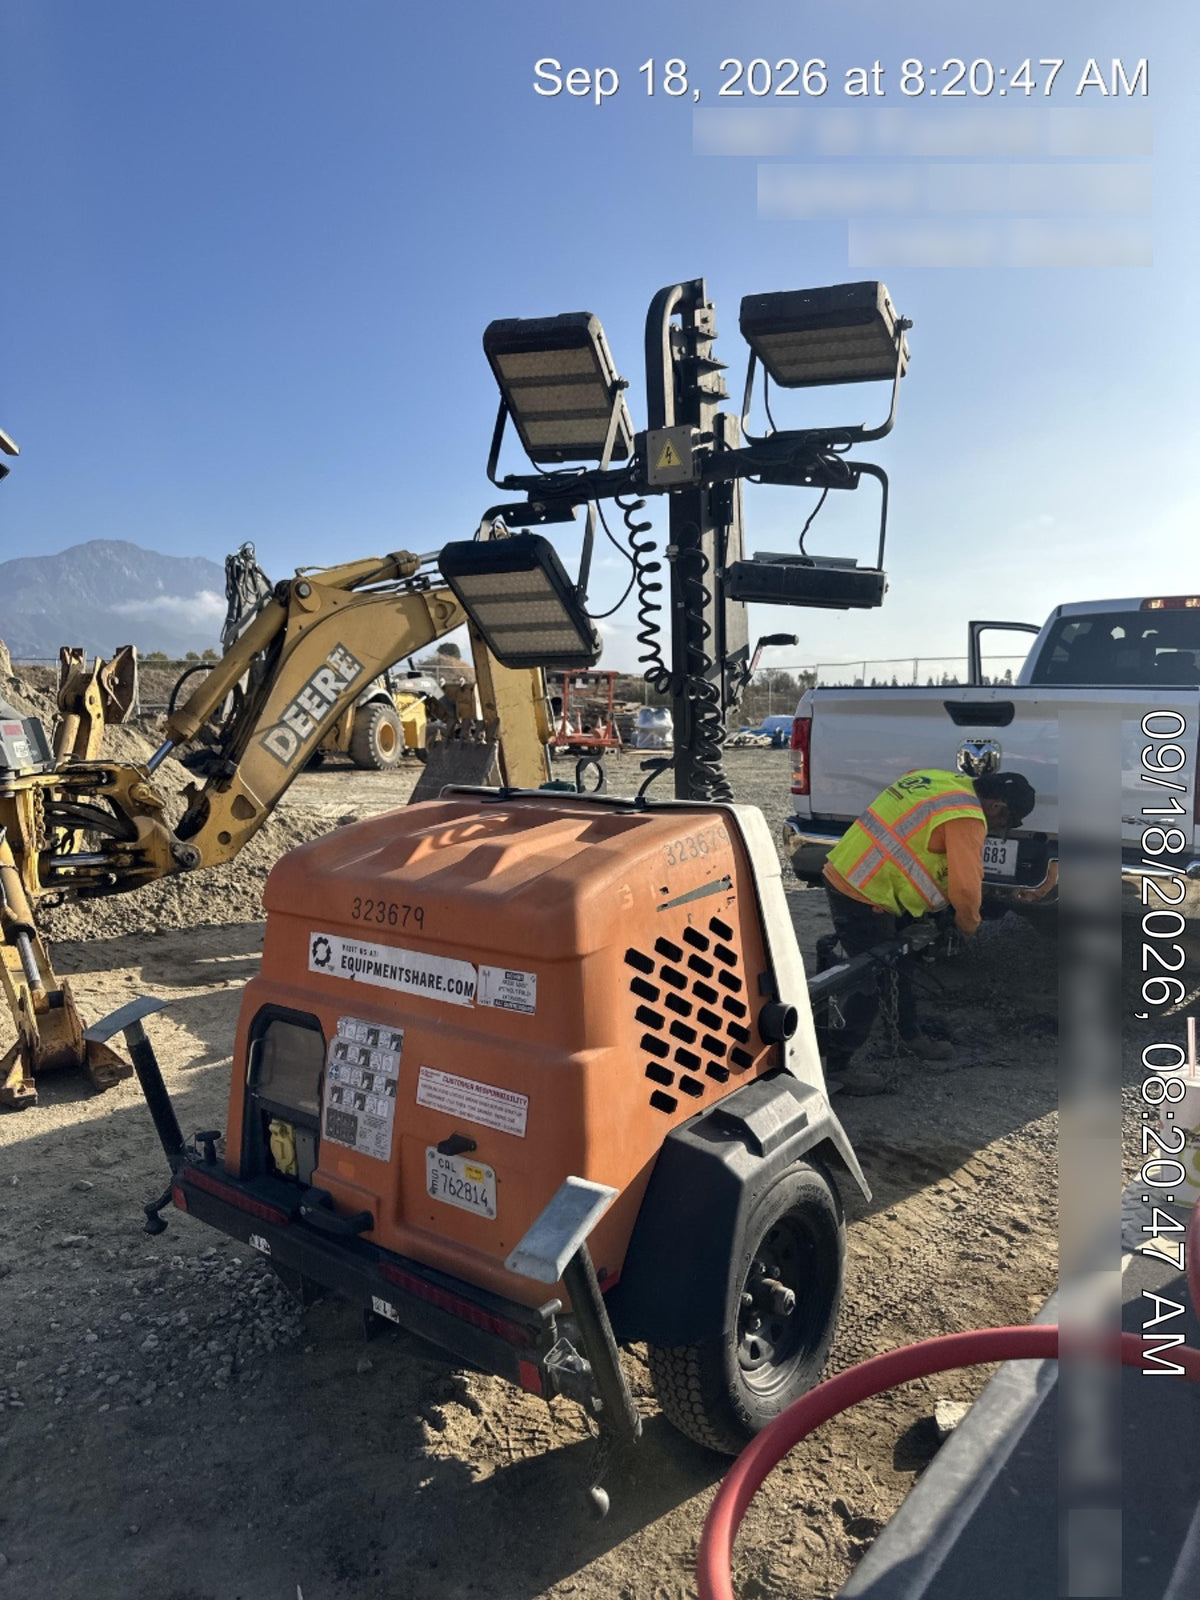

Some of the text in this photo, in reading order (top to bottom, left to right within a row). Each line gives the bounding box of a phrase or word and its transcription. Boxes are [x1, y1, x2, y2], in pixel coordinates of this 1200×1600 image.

[263, 647, 361, 763] DEERE
[664, 826, 731, 867] 323679
[351, 896, 425, 931] 323679
[341, 954, 475, 998] EQUIPMENTSHARE.COM
[438, 1158, 457, 1174] CAL
[441, 1172, 488, 1208] 762814
